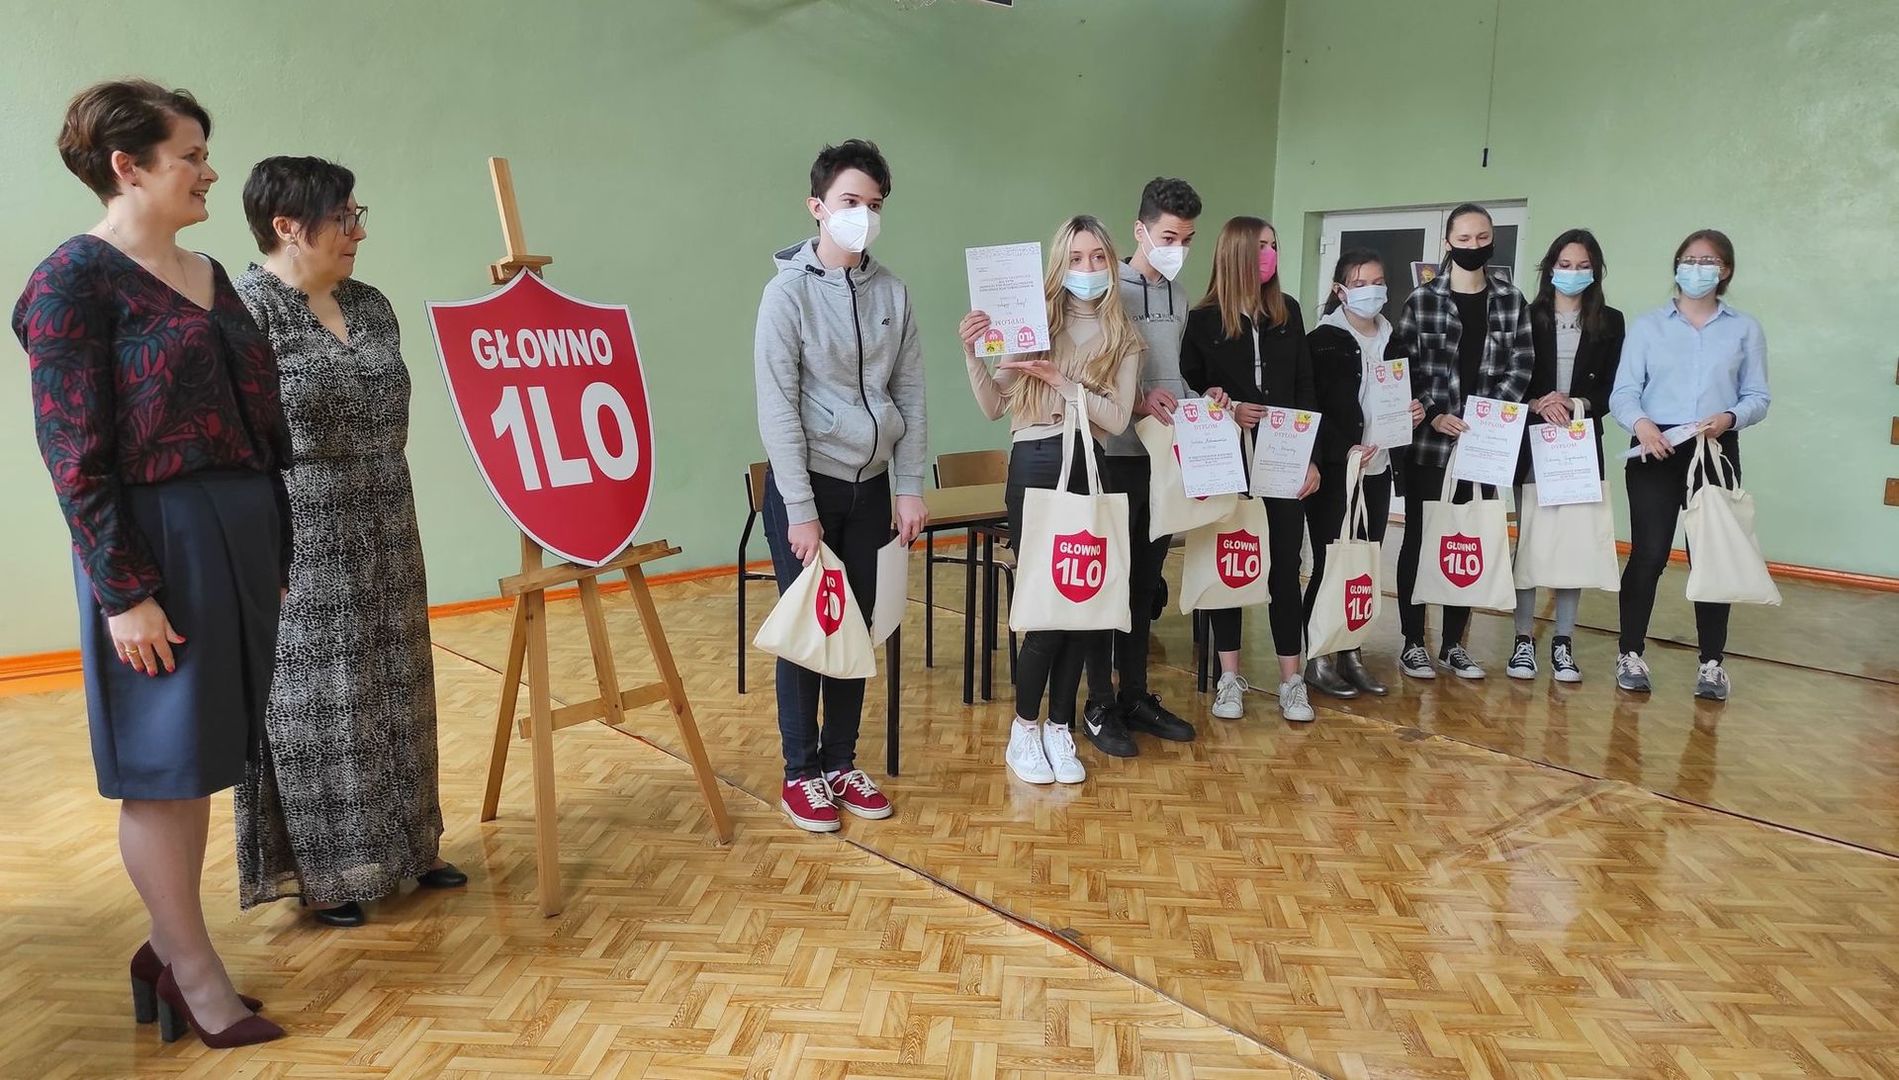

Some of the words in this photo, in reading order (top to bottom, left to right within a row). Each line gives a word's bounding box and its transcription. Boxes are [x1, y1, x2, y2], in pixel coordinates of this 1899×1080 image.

[470, 329, 613, 370] GŁOWNO
[490, 382, 639, 491] 1LO
[1060, 541, 1101, 556] GŁOWNO
[1055, 557, 1102, 588] 1LO
[1220, 552, 1260, 578] 1LO
[1443, 553, 1481, 576] 1LO
